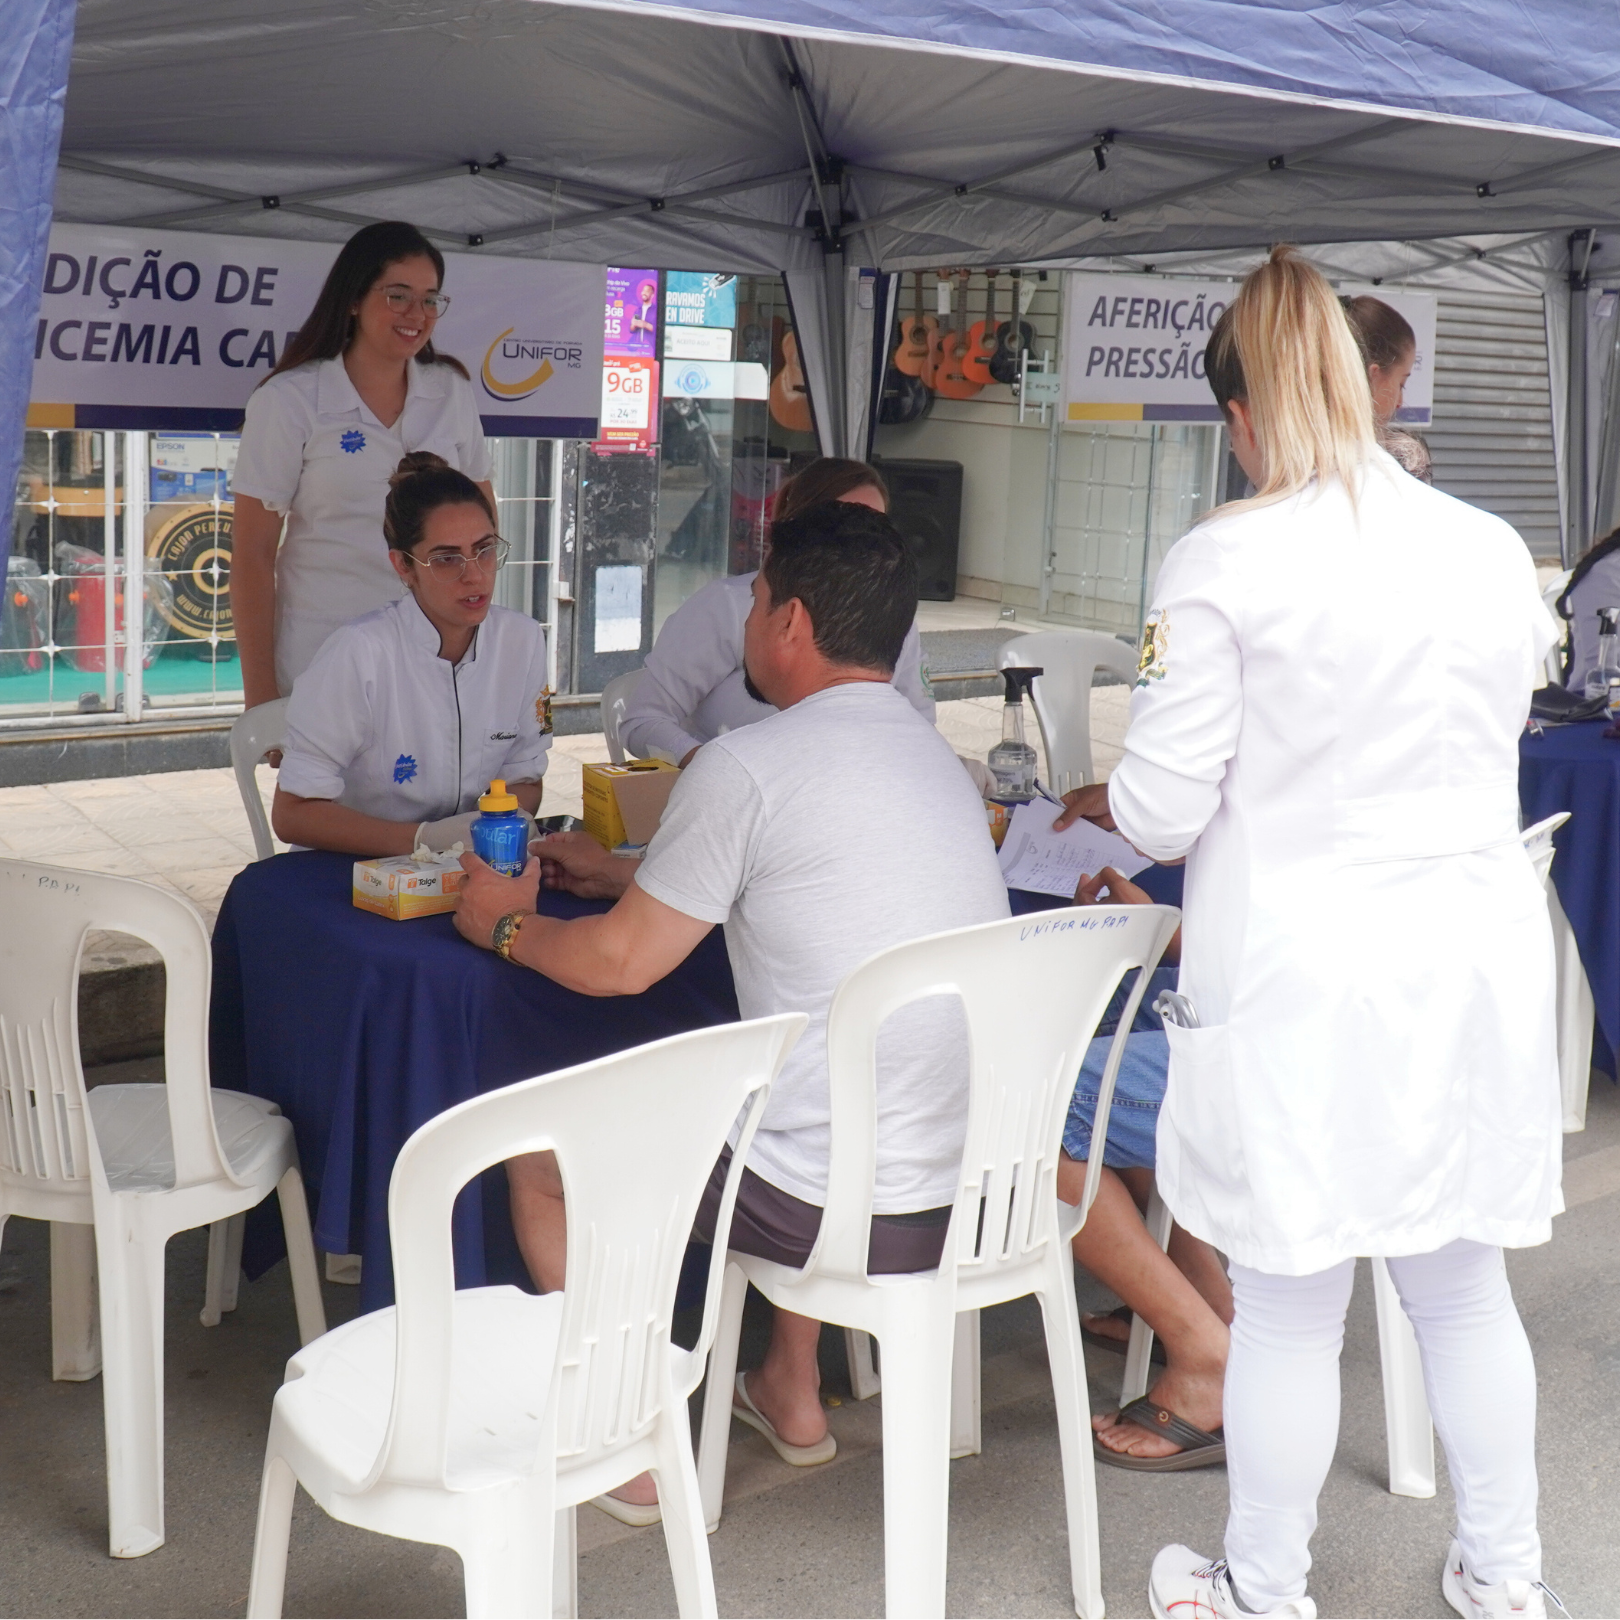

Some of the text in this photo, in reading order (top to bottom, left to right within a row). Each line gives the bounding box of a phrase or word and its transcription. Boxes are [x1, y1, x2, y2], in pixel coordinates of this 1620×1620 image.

[215, 264, 279, 306] DE
[679, 308, 705, 324] DRIVE
[1087, 293, 1227, 339] AFERIÇÃO
[503, 343, 582, 361] UNIFOR
[369, 876, 382, 887] Talge
[418, 878, 436, 887] Talge
